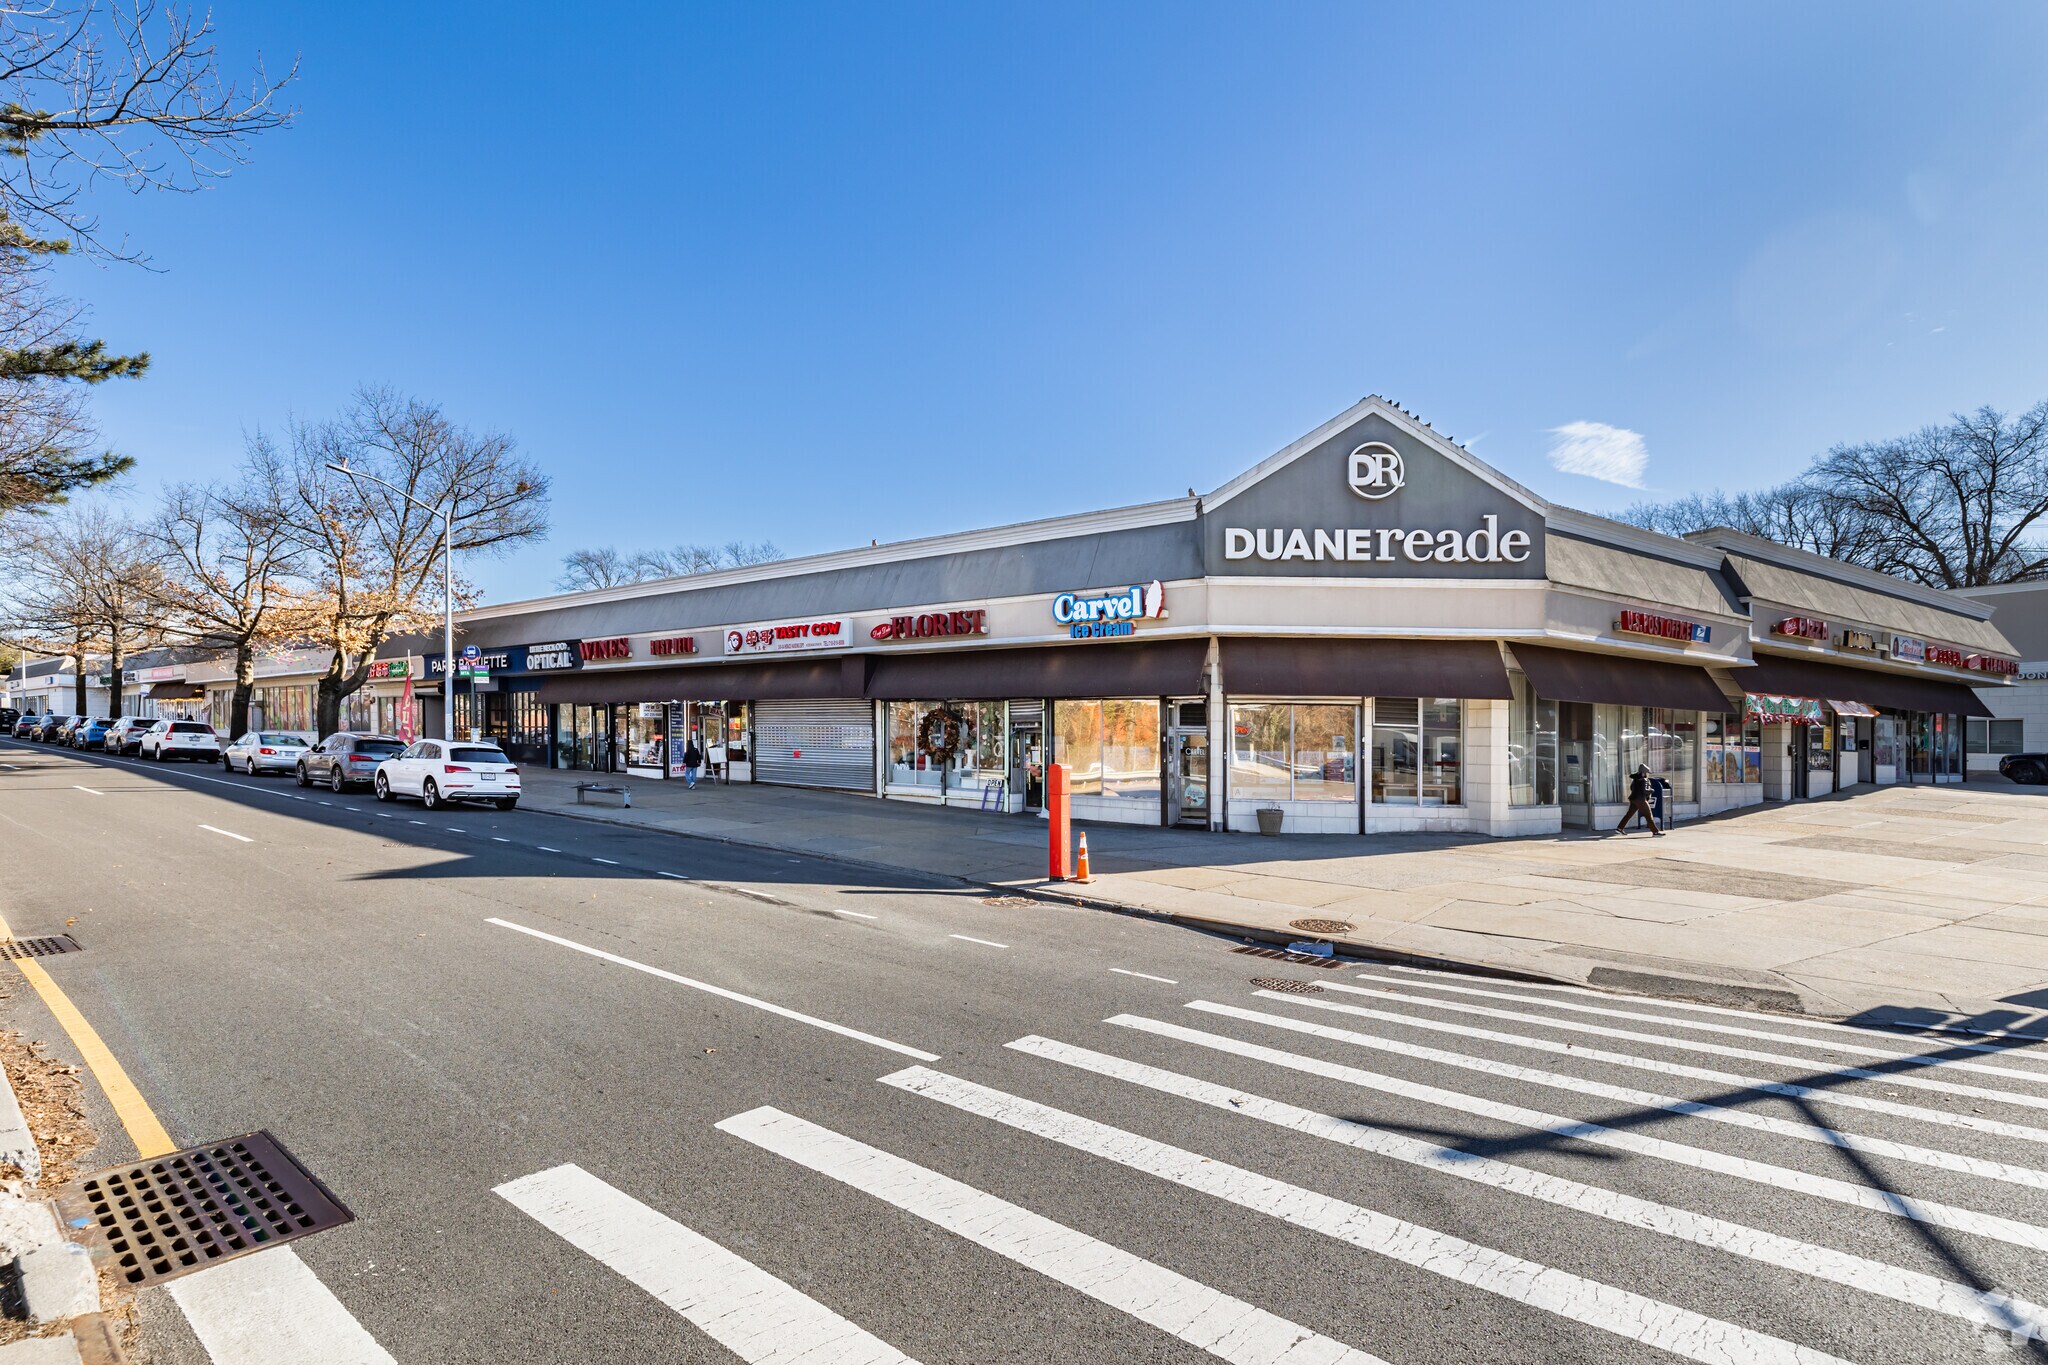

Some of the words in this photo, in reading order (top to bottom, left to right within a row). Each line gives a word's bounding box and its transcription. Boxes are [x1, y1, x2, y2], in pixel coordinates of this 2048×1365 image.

[1349, 453, 1405, 487] DR
[1225, 527, 1372, 562] DUANE
[1374, 514, 1531, 563] reade
[1053, 587, 1143, 623] Carvel
[774, 625, 810, 639] TASTY
[811, 621, 841, 637] COW
[890, 609, 986, 640] FLORIST
[1070, 624, 1090, 638] Ice
[1091, 622, 1134, 637] Cream
[1643, 613, 1666, 638] POST
[1666, 619, 1692, 641] OFFICE
[1799, 617, 1829, 641] PIZZA
[526, 651, 572, 670] OPTICAL
[579, 638, 629, 660] WINES
[431, 659, 457, 673] PARS
[458, 655, 508, 670] BAUETTE
[987, 779, 1002, 787] OPEN
